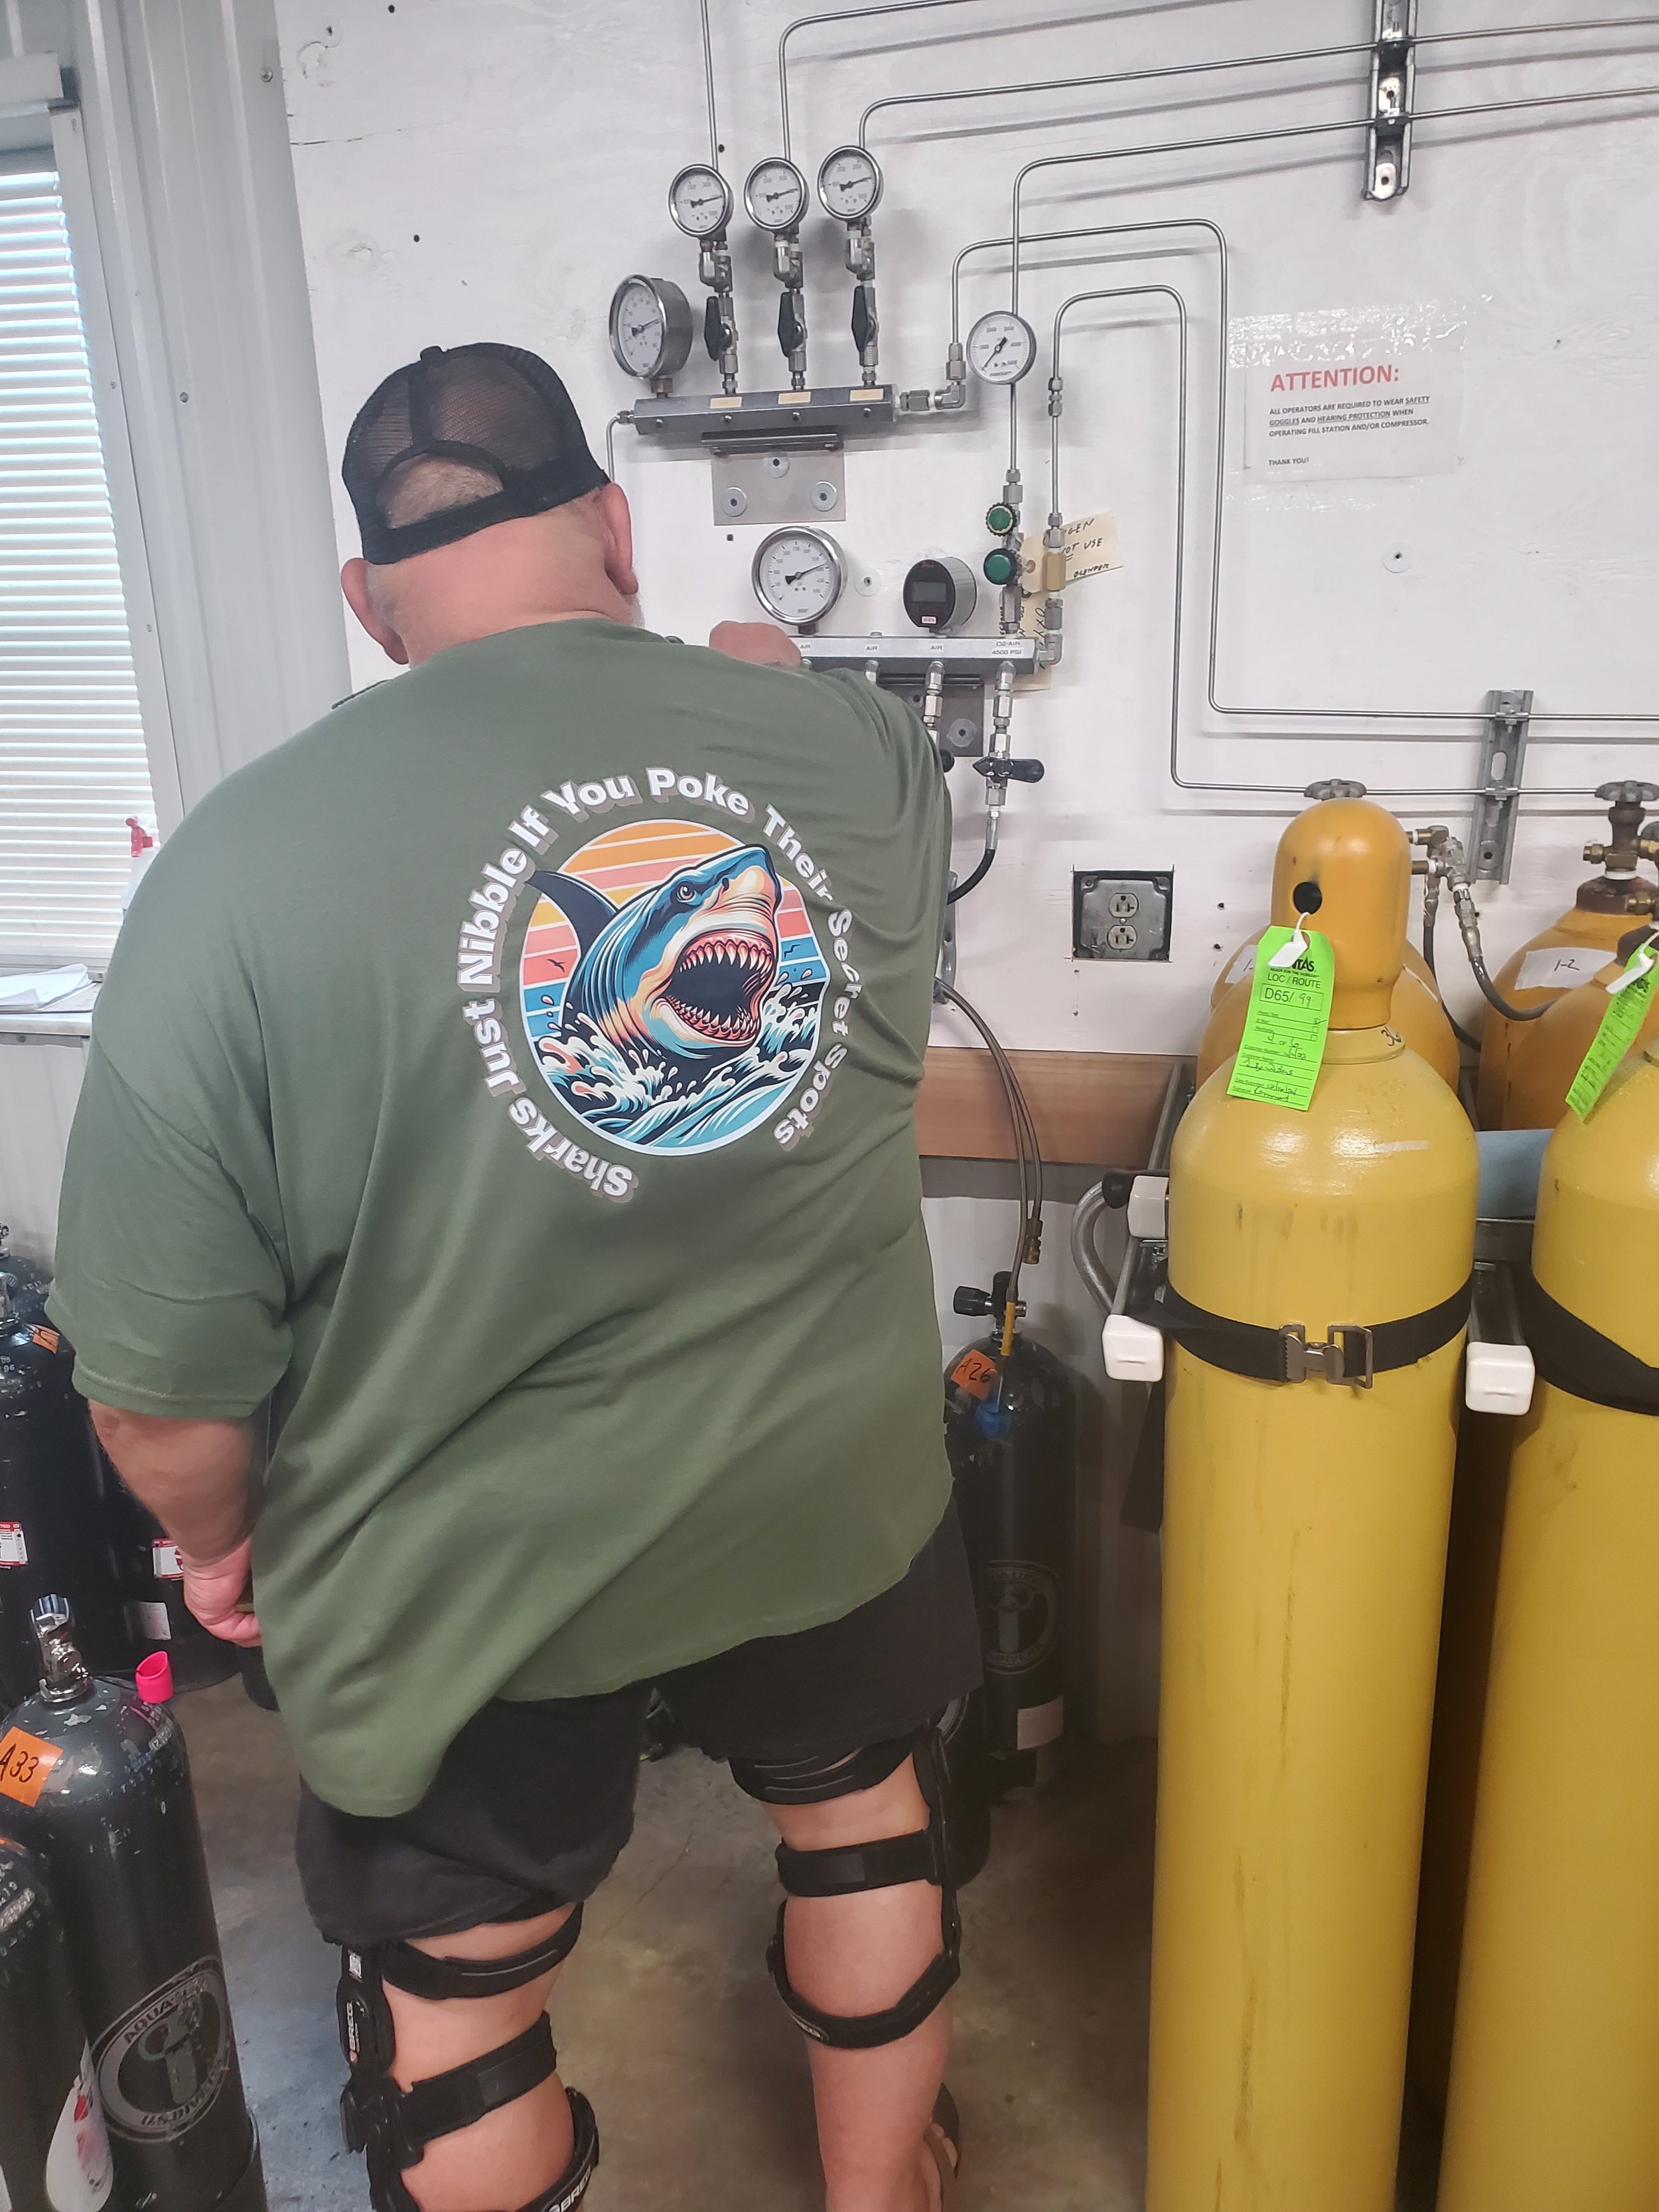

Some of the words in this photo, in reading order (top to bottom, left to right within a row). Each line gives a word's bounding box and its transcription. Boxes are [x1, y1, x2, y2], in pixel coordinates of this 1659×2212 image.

[1270, 365, 1399, 392] ATTENTION:
[1269, 417, 1299, 427] GOGGLES
[1317, 413, 1347, 423] HEARING
[1348, 410, 1391, 419] PROTECTION
[1282, 404, 1321, 414] OPERATORS
[1337, 401, 1371, 409] REQUIRED
[1269, 428, 1306, 437] OPERATING
[1352, 422, 1380, 431] AND/OR
[1381, 418, 1429, 428] COMPRESSOR.
[1084, 538, 1103, 550] USE
[543, 774, 636, 817] You
[646, 768, 751, 816] Poke
[509, 804, 551, 851] If
[764, 805, 835, 903] Their
[458, 848, 529, 988] Nibble
[828, 909, 862, 1037] Secret
[1267, 974, 1285, 982] LOC
[1292, 977, 1321, 988] ROUTE
[1553, 958, 1580, 972] 1-2
[464, 997, 520, 1094] Just
[509, 1096, 635, 1198] Sharks
[956, 1358, 991, 1383] A26
